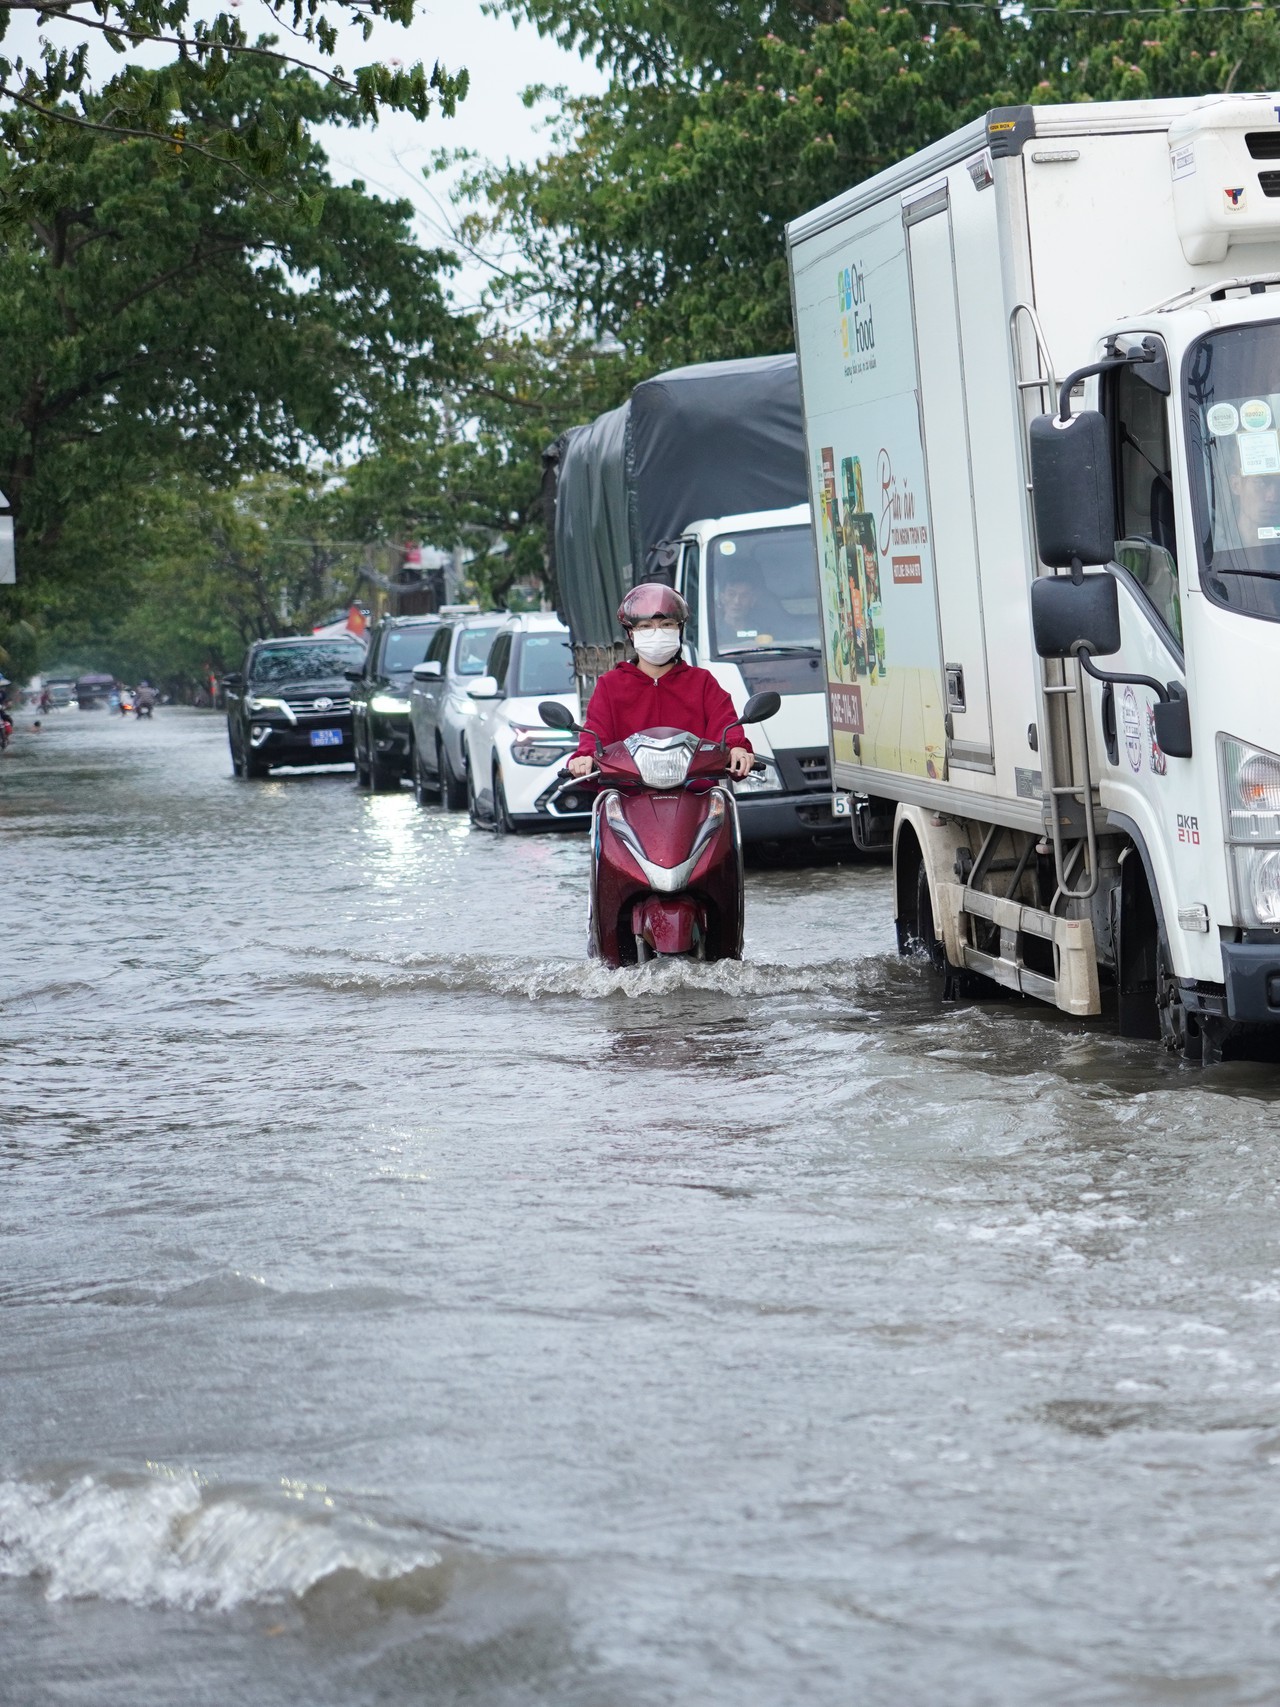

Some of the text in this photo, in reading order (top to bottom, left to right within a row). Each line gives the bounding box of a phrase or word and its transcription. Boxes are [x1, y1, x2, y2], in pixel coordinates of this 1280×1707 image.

[851, 259, 866, 306] Ori
[854, 304, 875, 352] Food
[1178, 828, 1200, 846] 210
